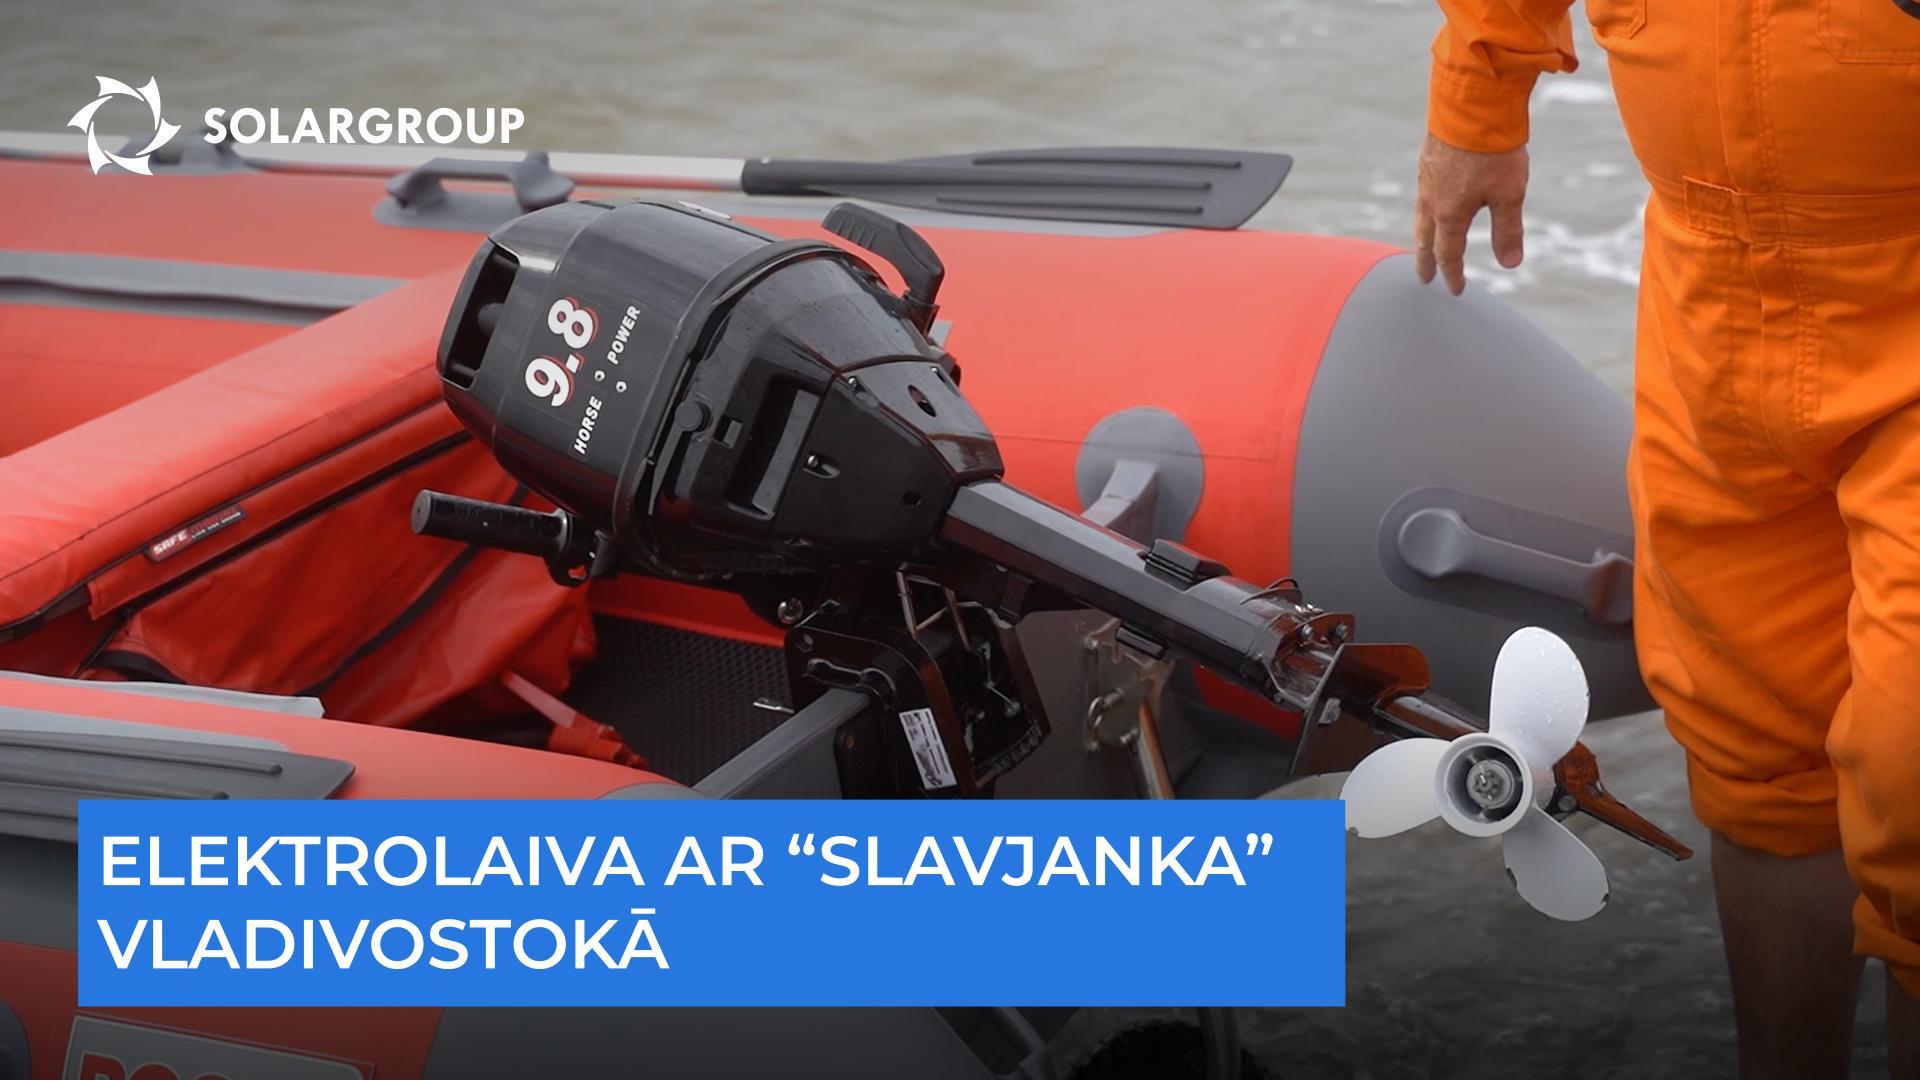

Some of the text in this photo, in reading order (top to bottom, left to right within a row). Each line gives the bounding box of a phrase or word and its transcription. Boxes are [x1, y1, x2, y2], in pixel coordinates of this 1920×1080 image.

[524, 296, 600, 408] 9.8
[573, 304, 641, 456] HORSE POWER
